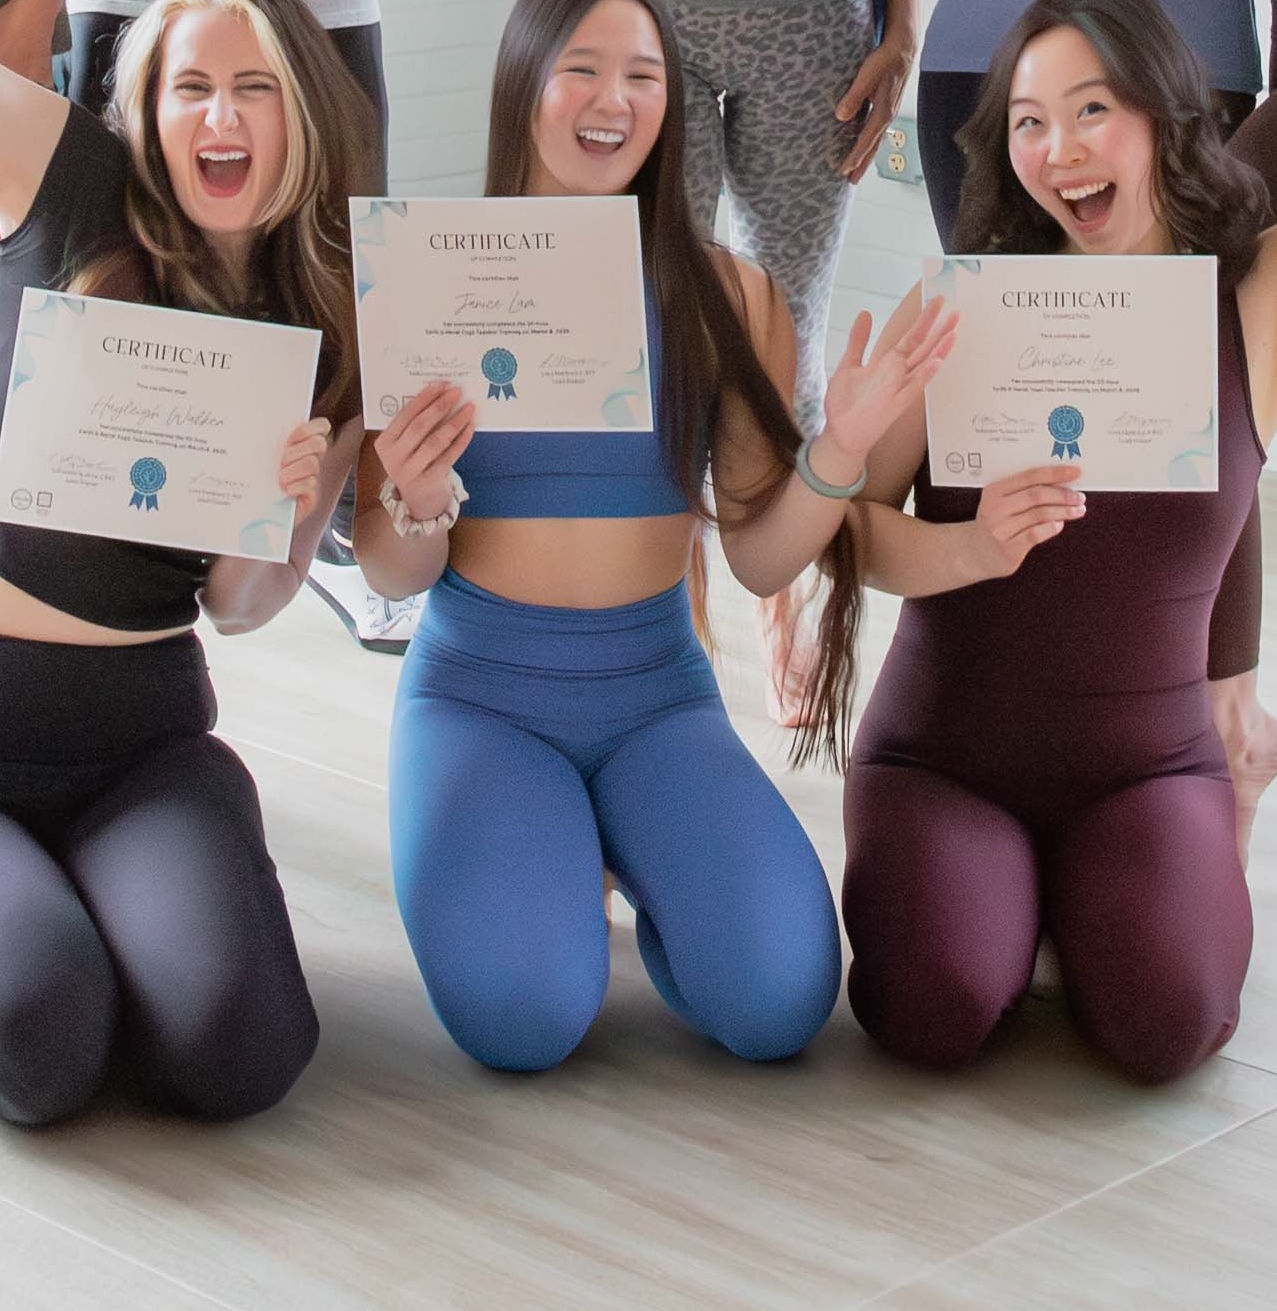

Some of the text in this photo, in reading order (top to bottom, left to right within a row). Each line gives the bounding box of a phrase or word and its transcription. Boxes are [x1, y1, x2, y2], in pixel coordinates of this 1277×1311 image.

[429, 232, 557, 250] CERTIFICATE
[1001, 291, 1131, 308] CERTIFICATE
[102, 336, 233, 370] CERTIFICATE
